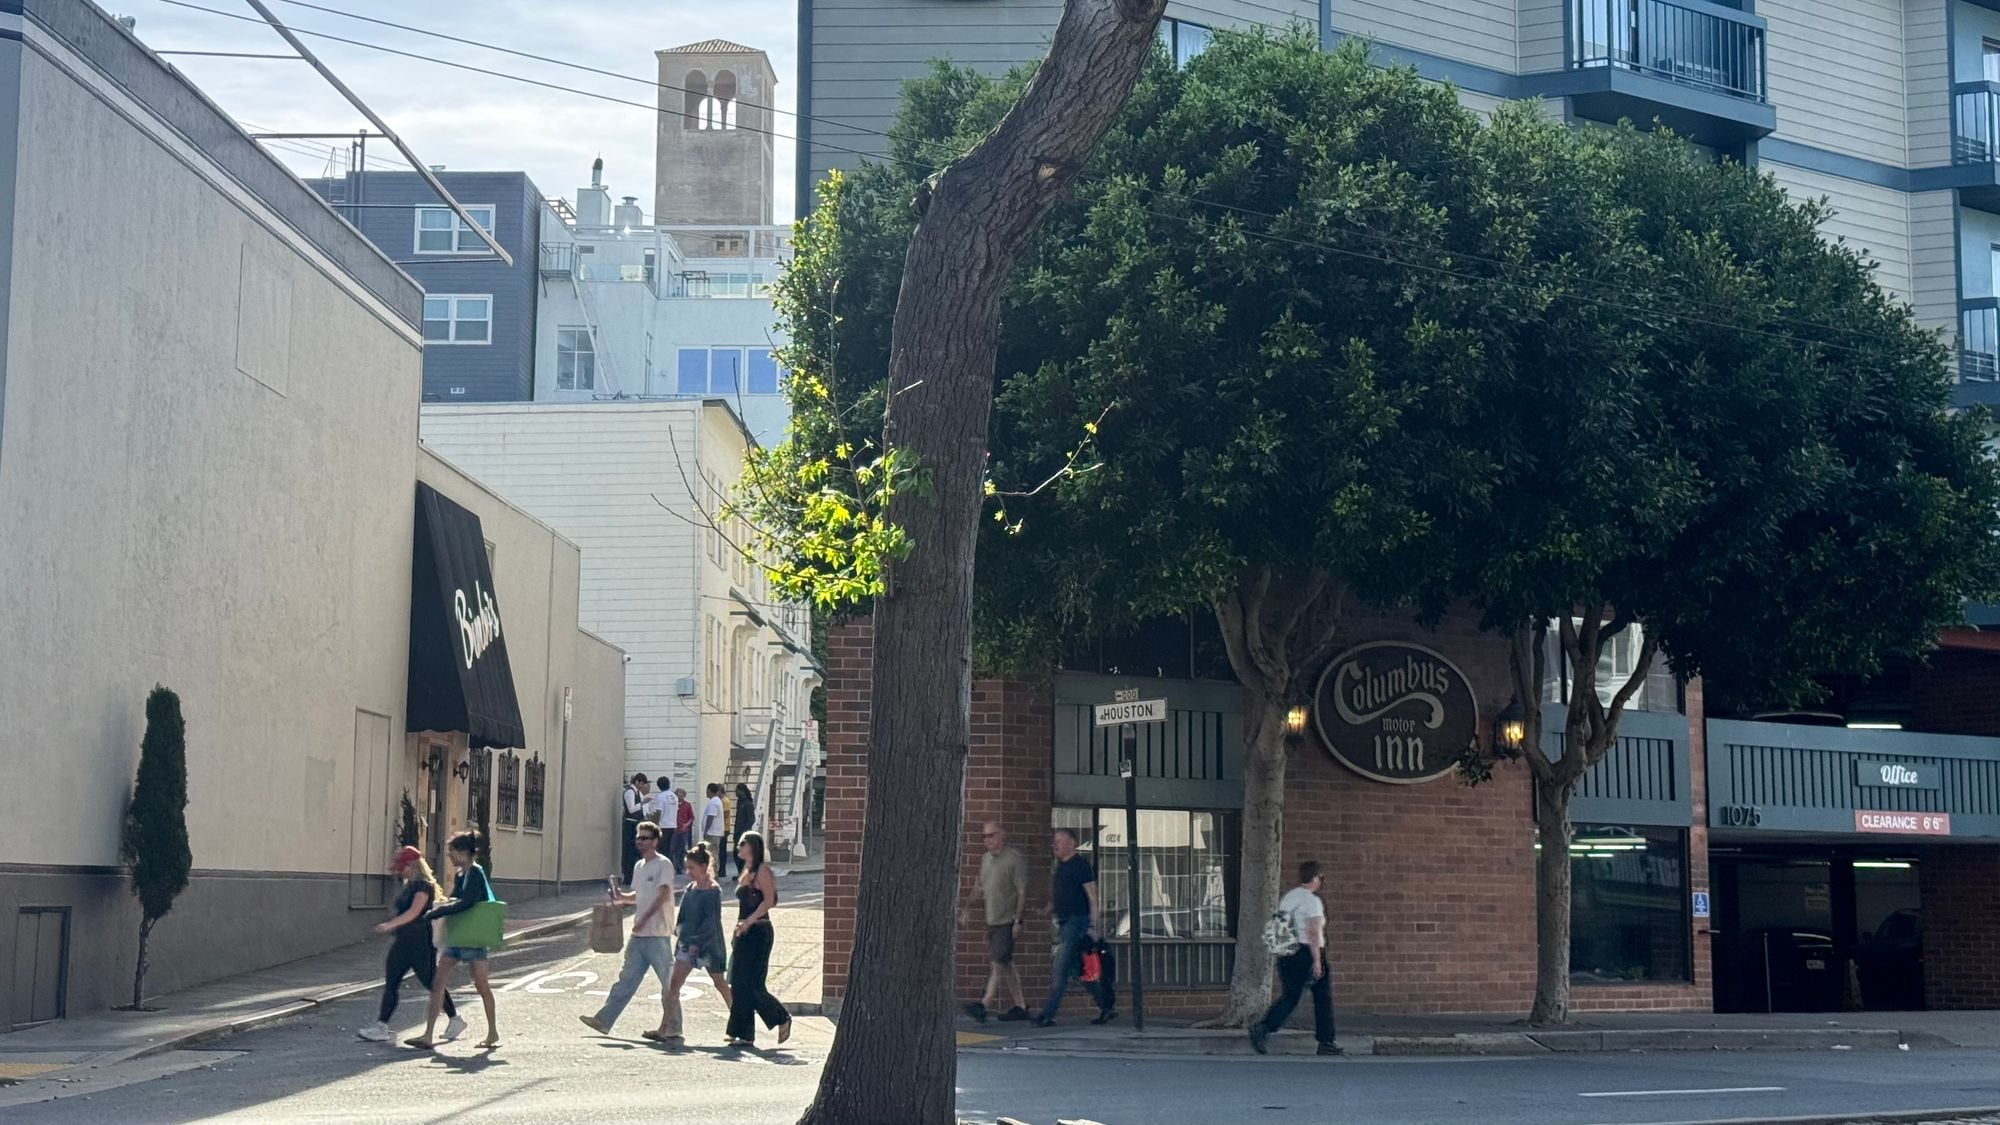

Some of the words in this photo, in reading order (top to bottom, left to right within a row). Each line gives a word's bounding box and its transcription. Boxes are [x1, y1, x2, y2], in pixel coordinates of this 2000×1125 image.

[455, 580, 499, 669] Bimbo's
[1334, 656, 1449, 728] Columbus
[1104, 704, 1153, 720] HOUSTON
[1880, 765, 1918, 784] Office
[1721, 806, 1762, 826] 1075
[1861, 814, 1918, 830] CLEARANCE
